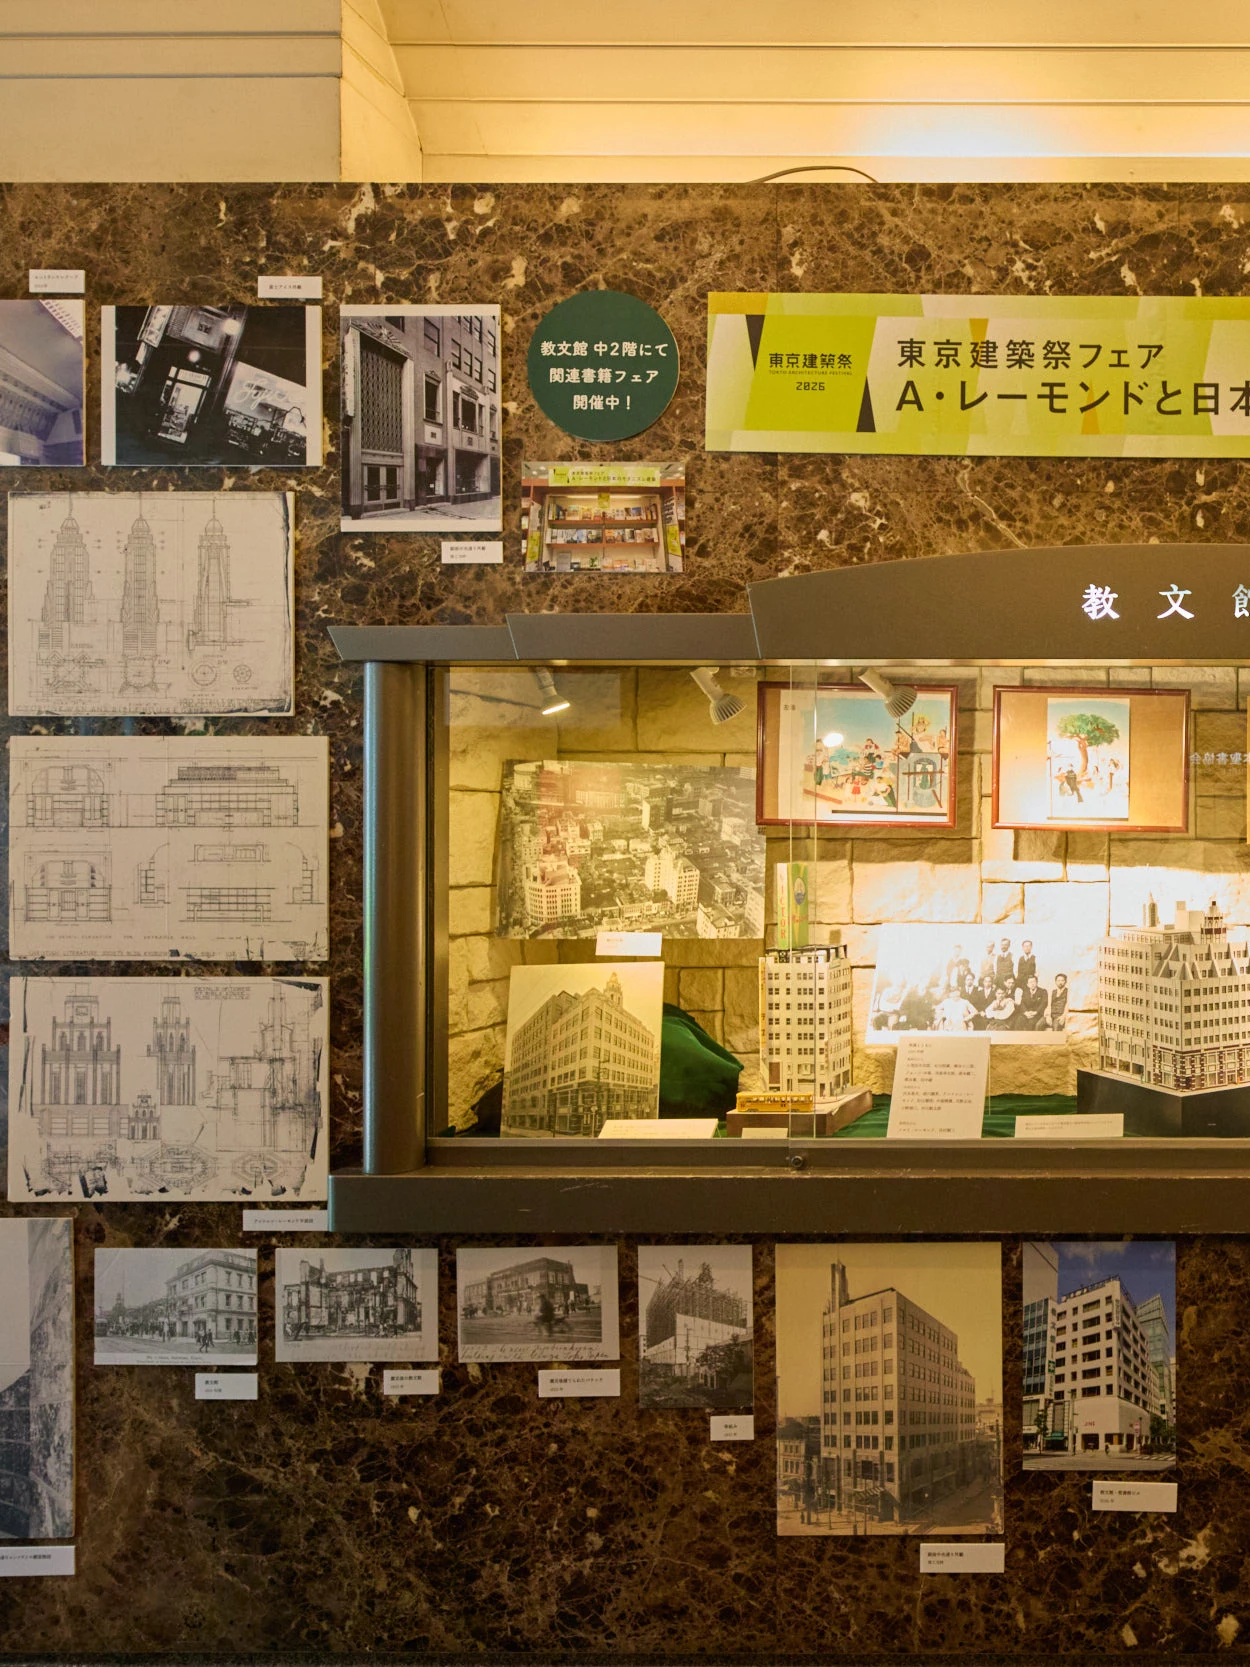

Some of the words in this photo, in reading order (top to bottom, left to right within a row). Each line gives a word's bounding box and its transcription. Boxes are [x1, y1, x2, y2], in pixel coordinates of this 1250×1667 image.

[540, 341, 588, 357] 教文館
[593, 341, 669, 357] 中2階にて
[896, 337, 1165, 370] 東京建築祭フェア
[768, 353, 853, 369] 東京建築祭
[549, 367, 659, 384] 関連書籍フェア
[796, 382, 826, 391] 2026
[573, 395, 631, 410] 開催中！
